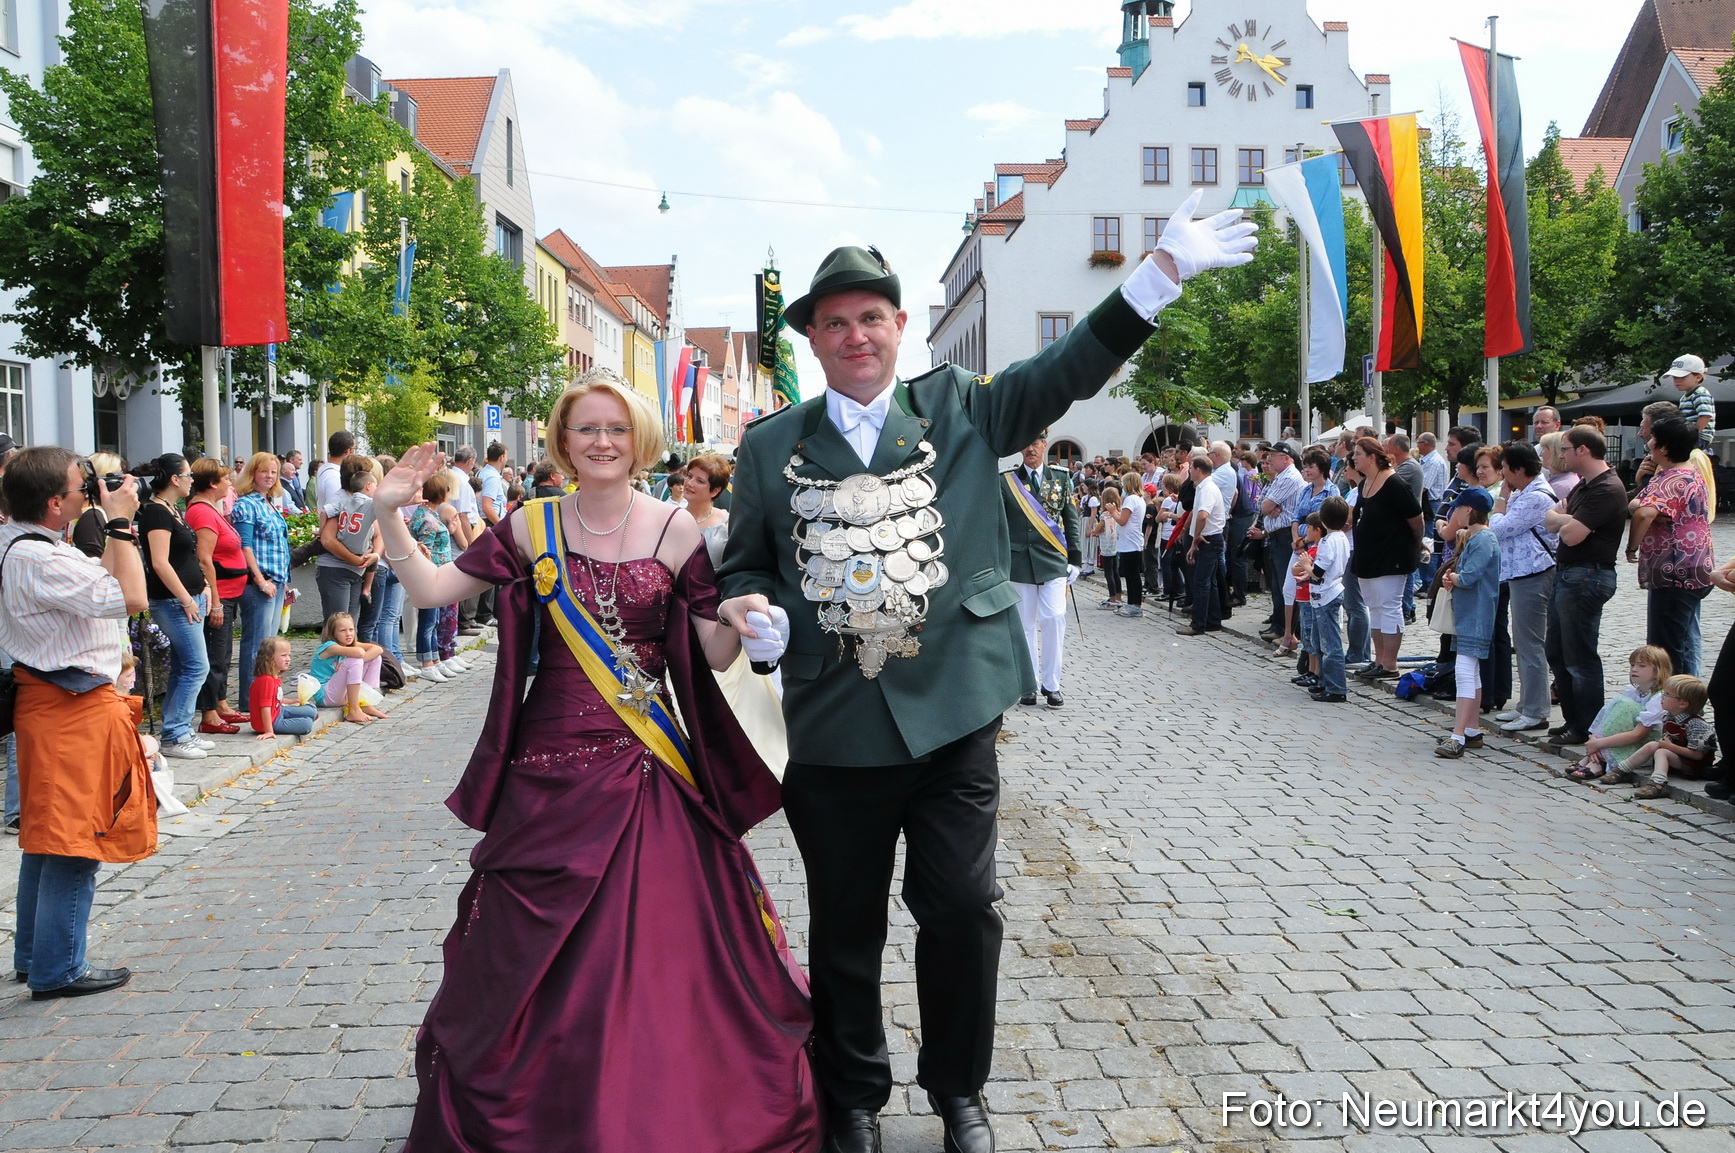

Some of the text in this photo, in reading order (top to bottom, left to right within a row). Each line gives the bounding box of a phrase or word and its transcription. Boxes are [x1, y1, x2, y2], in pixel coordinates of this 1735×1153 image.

[1227, 23, 1243, 42] XI
[1245, 20, 1256, 37] XII
[1215, 37, 1233, 51] X
[1211, 55, 1228, 64] IX
[489, 408, 498, 427] P
